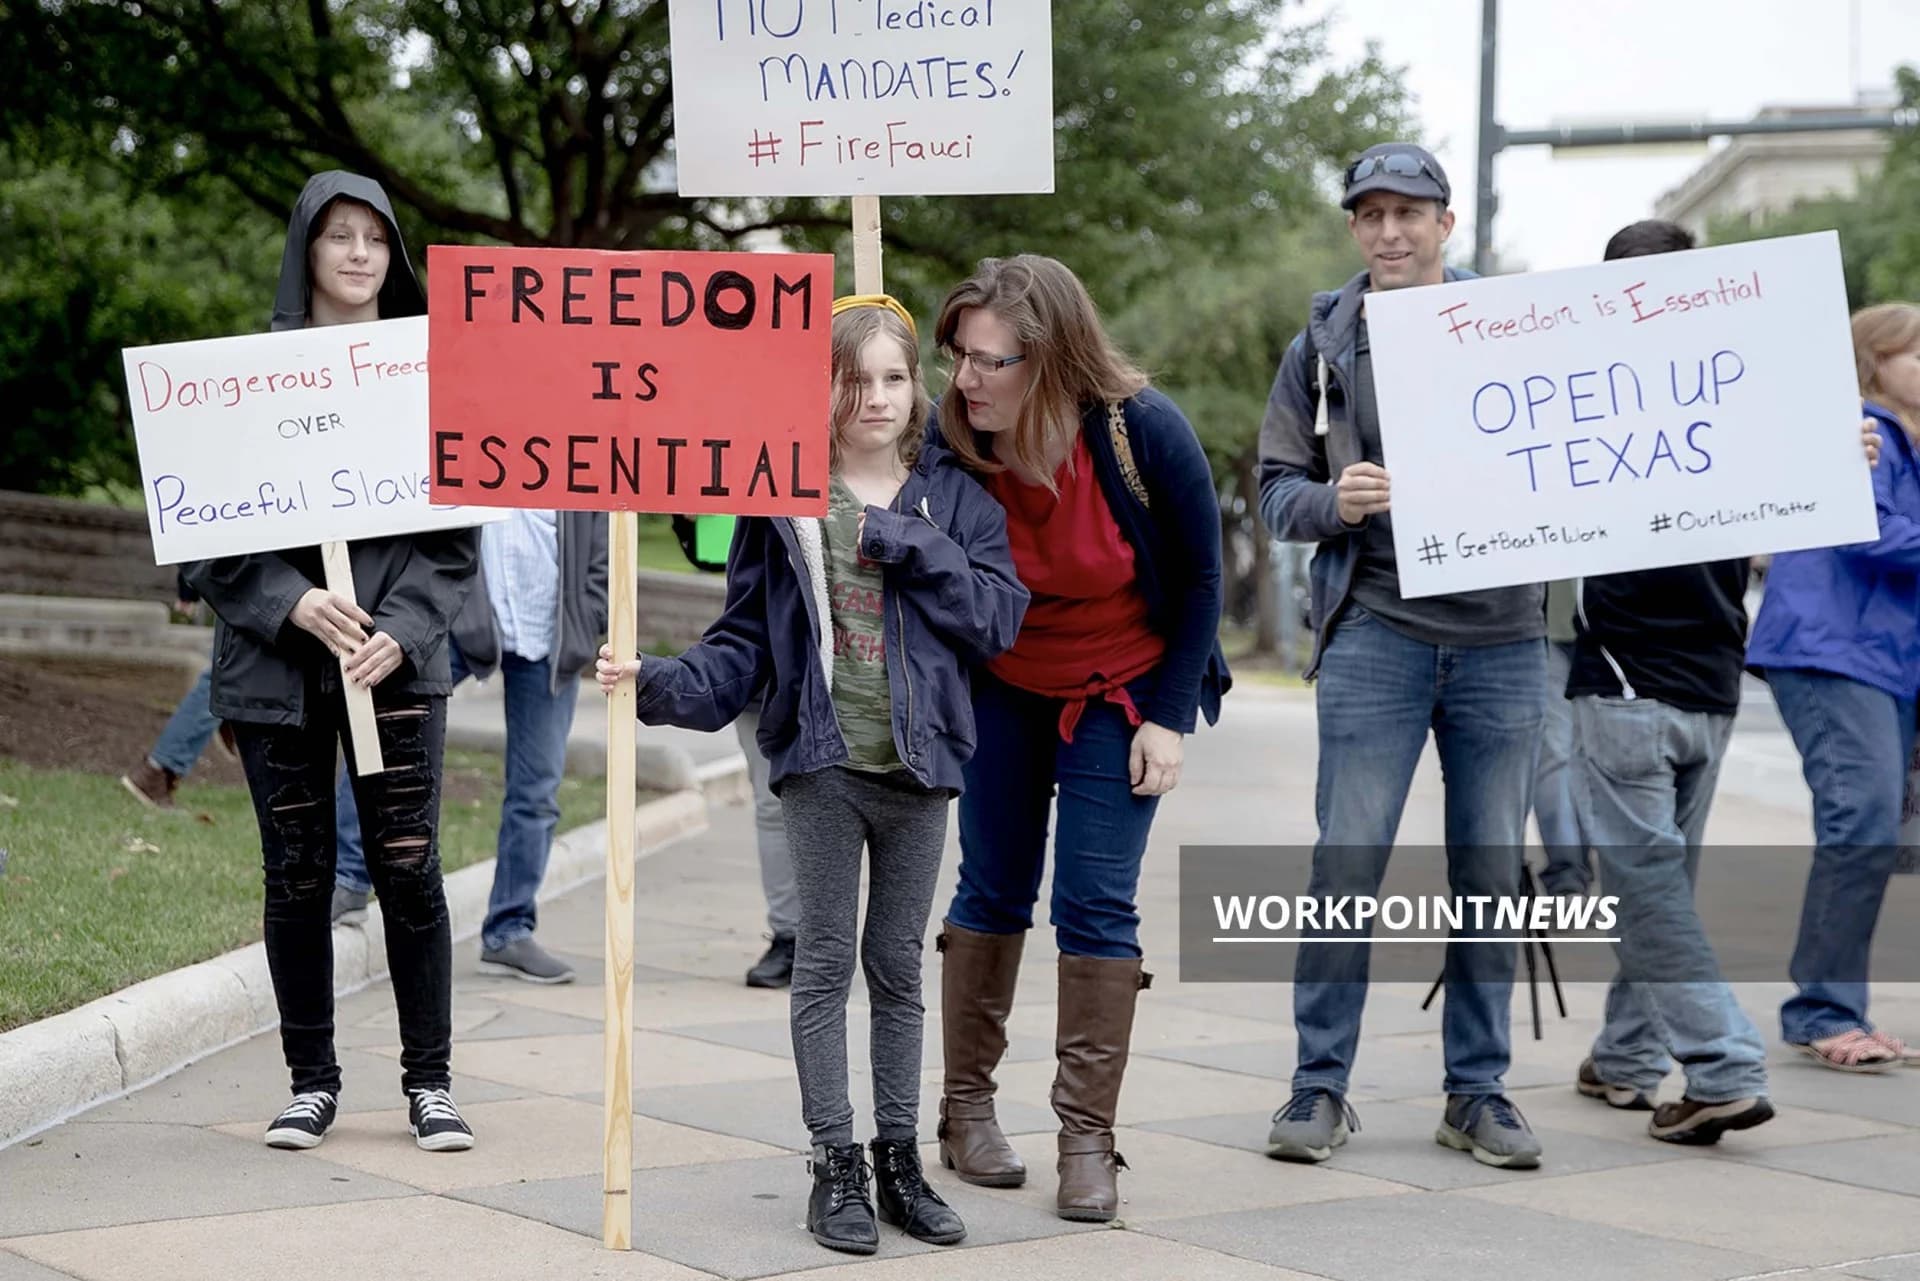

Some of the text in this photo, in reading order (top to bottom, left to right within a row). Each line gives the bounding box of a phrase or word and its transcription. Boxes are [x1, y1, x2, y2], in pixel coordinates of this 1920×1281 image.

[759, 50, 1024, 101] MANDATES!
[464, 265, 811, 330] FREEDOM
[1438, 271, 1763, 344] Freedom is Essential
[138, 361, 332, 412] Dangerous
[592, 362, 658, 401] IS
[1472, 350, 1745, 433] OPEN UP
[277, 413, 345, 438] OVER
[1506, 421, 1713, 492] TEXAS
[435, 431, 821, 499] ESSENTIAL
[153, 475, 308, 534] Peaceful
